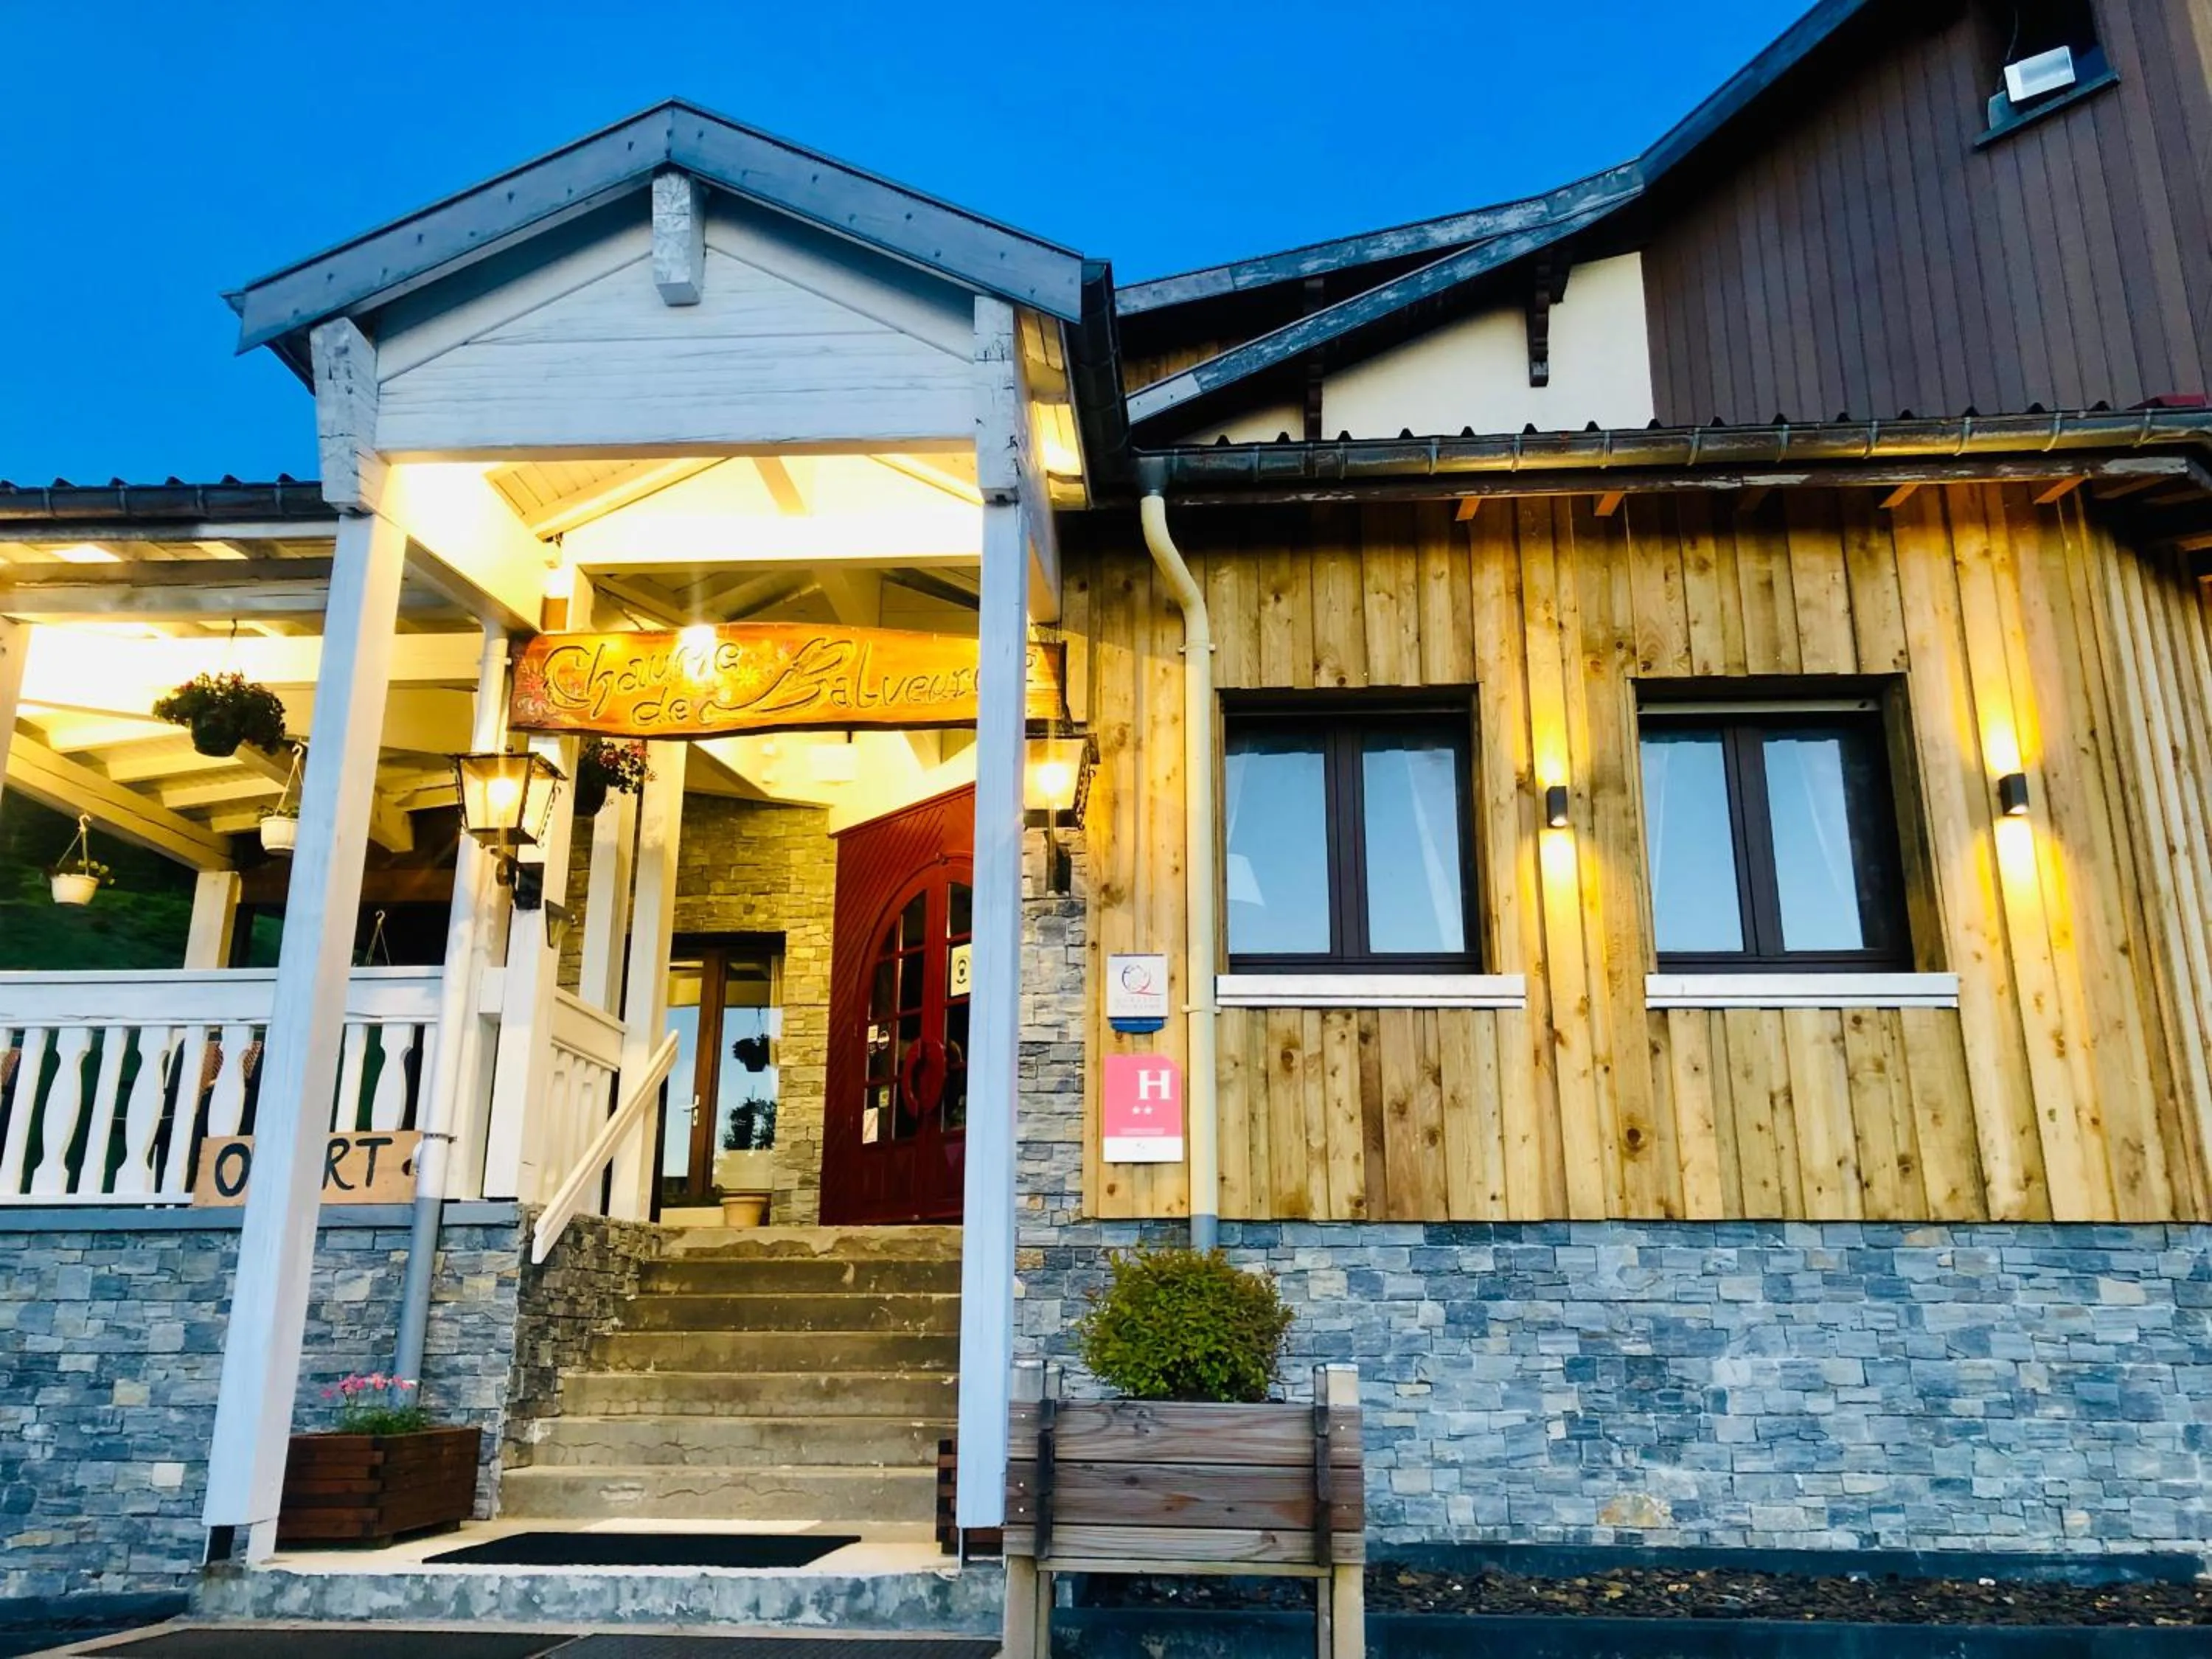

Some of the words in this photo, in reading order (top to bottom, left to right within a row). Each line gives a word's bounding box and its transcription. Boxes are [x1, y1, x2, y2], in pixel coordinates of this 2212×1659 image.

[632, 686, 689, 726] de
[698, 637, 1036, 724] Balveur
[1138, 1069, 1172, 1101] H
[215, 1138, 393, 1197] ORT
